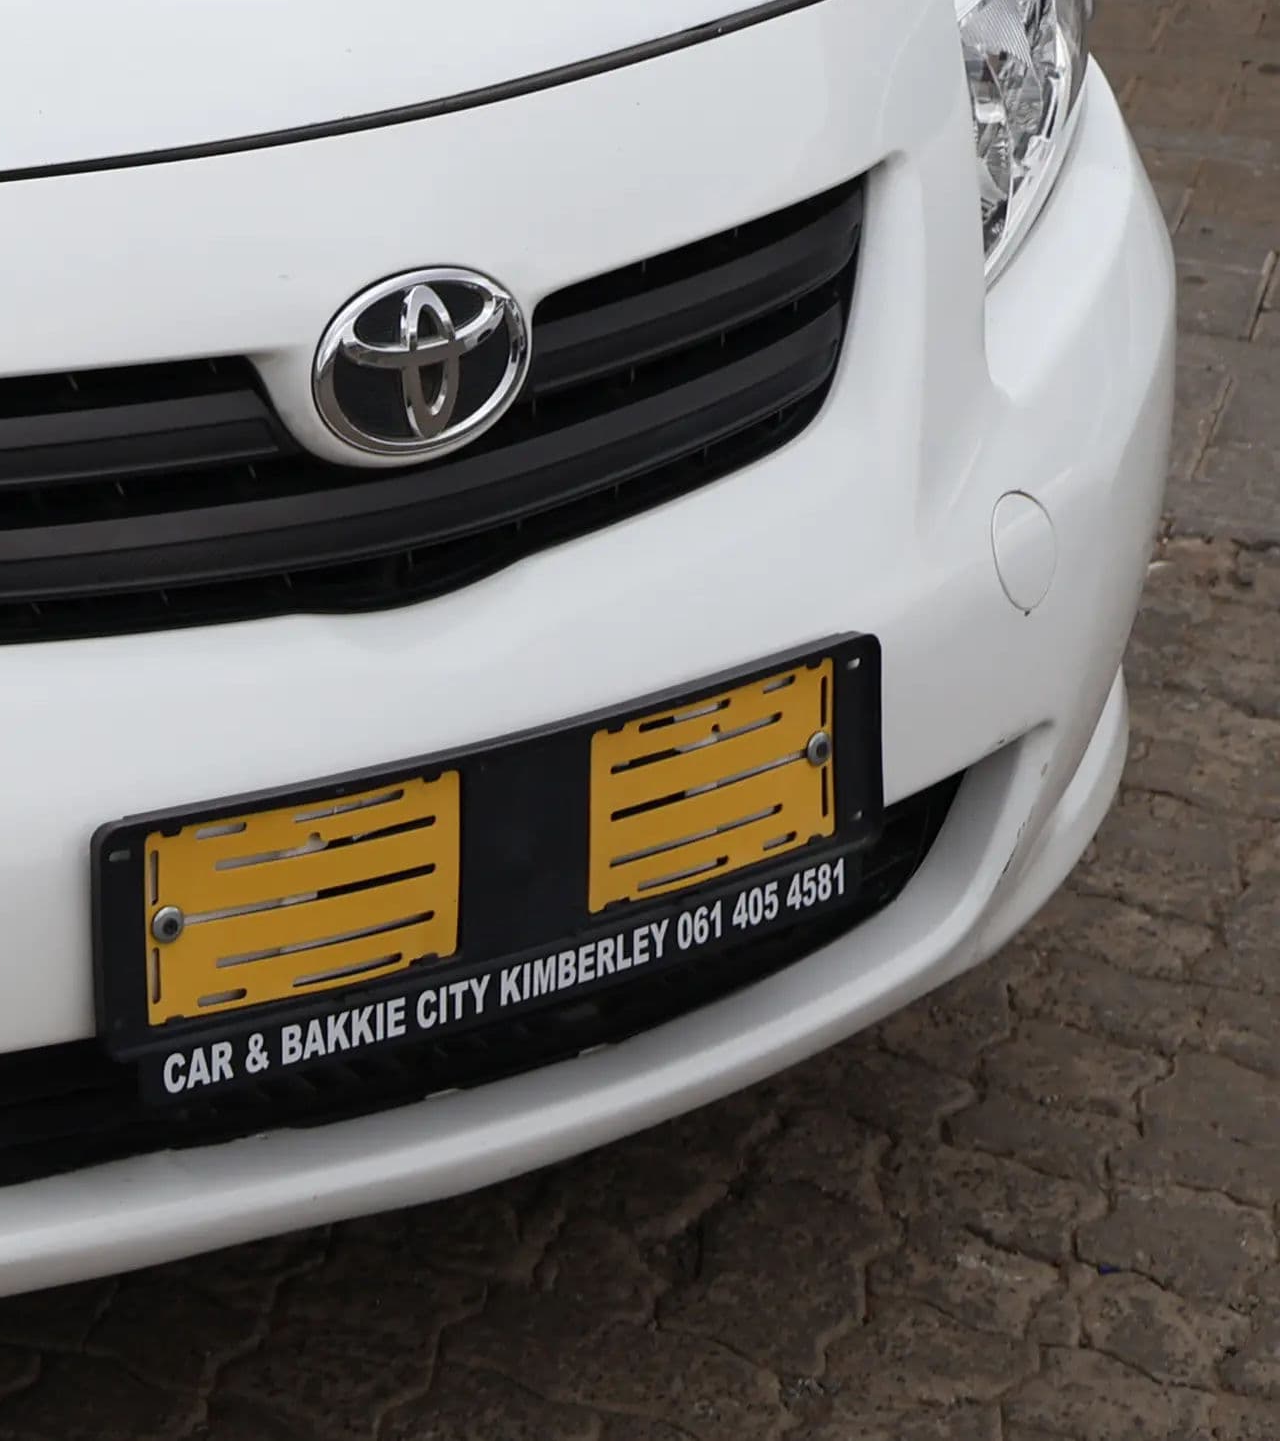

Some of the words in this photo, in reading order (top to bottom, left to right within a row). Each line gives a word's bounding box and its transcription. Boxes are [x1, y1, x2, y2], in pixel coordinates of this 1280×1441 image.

[163, 1041, 234, 1094] CAR
[245, 1032, 270, 1074] &
[281, 997, 407, 1066] BAKKIE
[416, 974, 491, 1030] CITY
[500, 918, 670, 1007] KIMBERLEY
[677, 900, 723, 951] 061
[732, 880, 779, 930] 405
[786, 857, 845, 911] 4581
